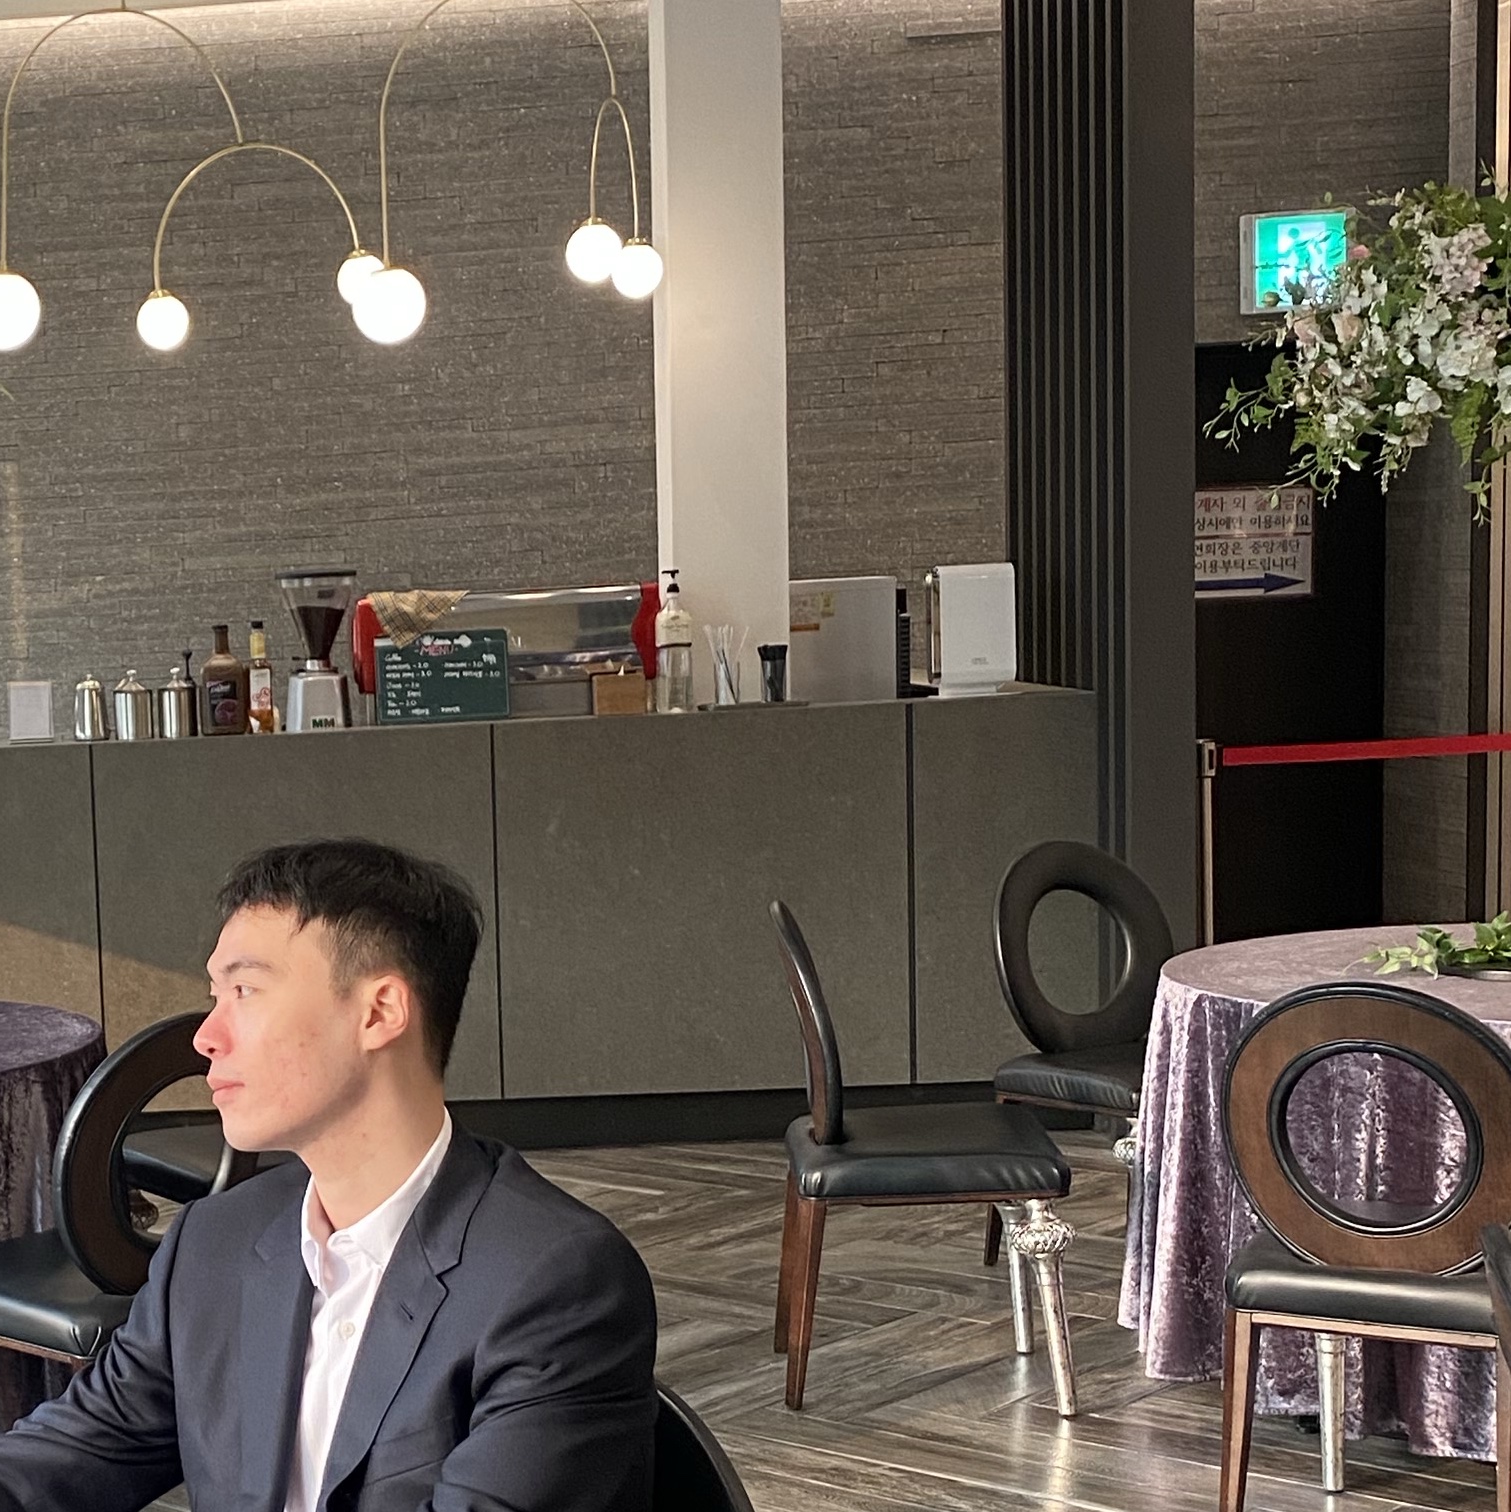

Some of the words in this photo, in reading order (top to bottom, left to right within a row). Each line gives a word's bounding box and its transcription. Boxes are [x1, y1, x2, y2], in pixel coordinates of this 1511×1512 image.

[1232, 495, 1246, 511] 외
[1254, 494, 1311, 511] 출금지
[1249, 539, 1301, 554] 중앙계단
